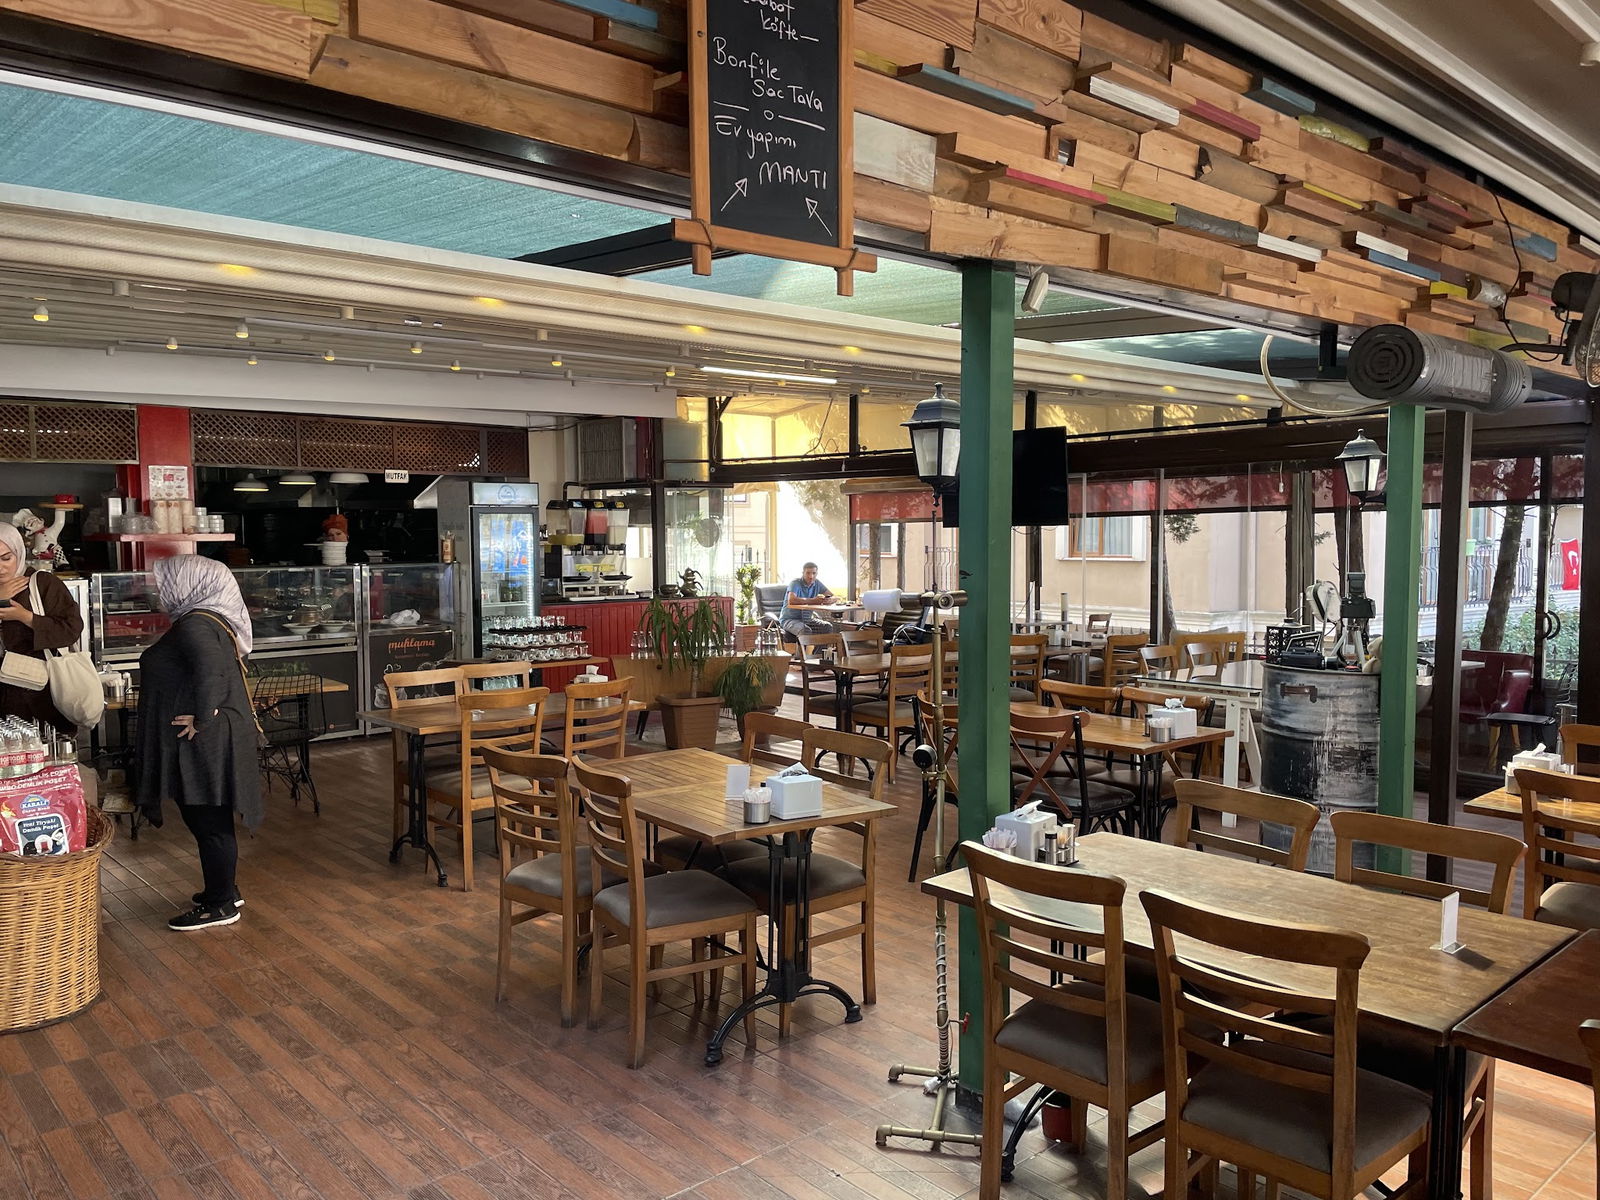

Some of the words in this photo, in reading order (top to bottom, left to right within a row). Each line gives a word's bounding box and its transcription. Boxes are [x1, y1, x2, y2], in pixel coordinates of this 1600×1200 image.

[713, 36, 781, 80] Bonfile
[752, 79, 785, 99] Sac
[759, 161, 828, 190] MANTI
[385, 472, 408, 480] MUTFAK
